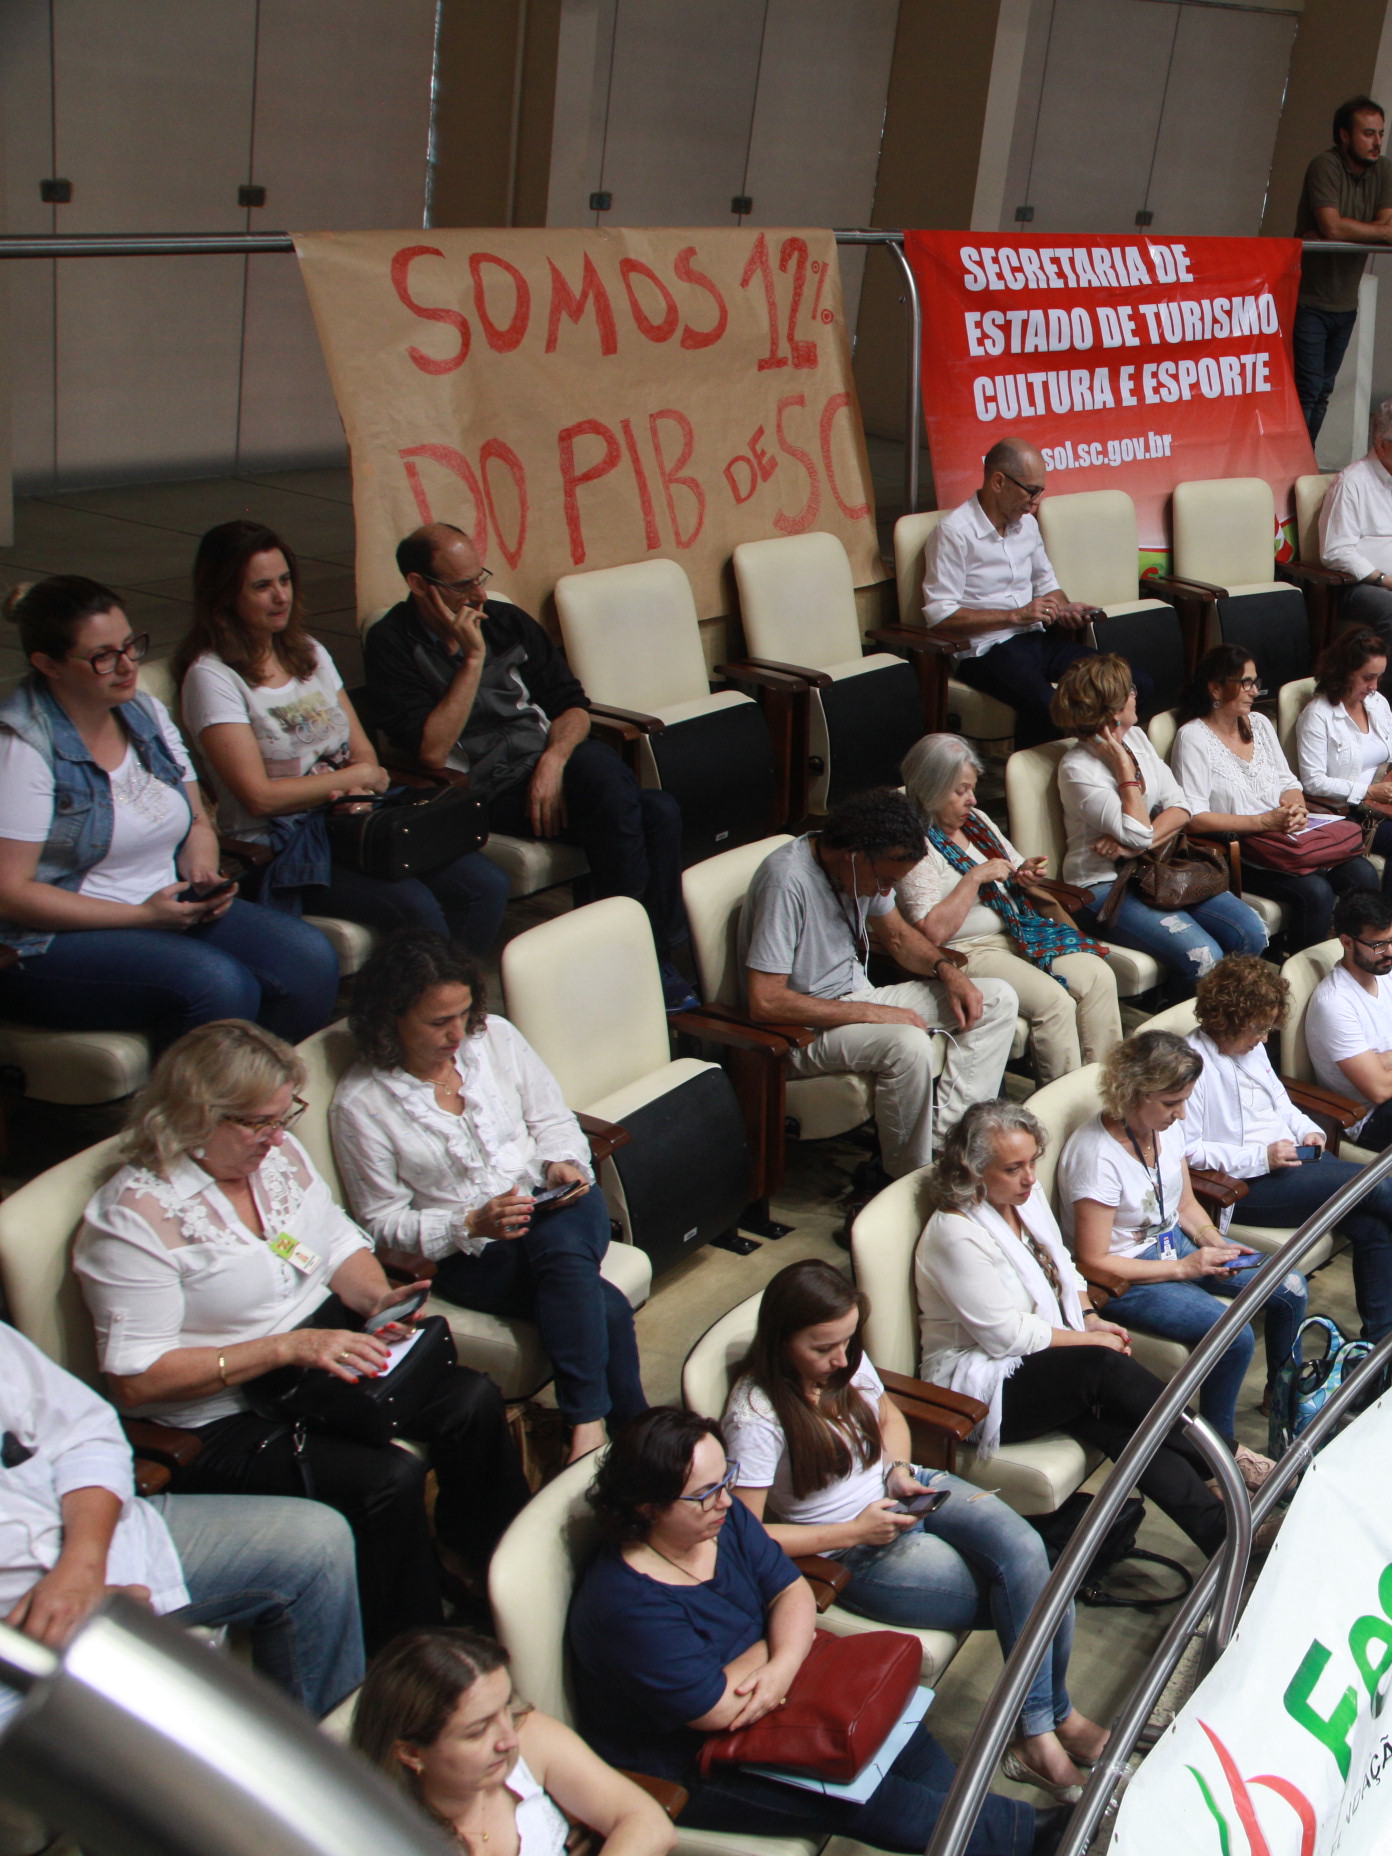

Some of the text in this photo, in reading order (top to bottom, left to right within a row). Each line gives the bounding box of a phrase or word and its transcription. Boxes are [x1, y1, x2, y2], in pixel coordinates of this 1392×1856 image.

[959, 244, 1194, 292] SECRETARIA DE
[390, 231, 833, 376] SOMOS 12%
[964, 307, 1094, 357] ESTADO
[1096, 305, 1140, 349] DE
[973, 352, 1271, 422] CULTURA E ESPORTE
[399, 392, 871, 571] DO PIB DE SC
[981, 431, 1172, 472] sol.sc.gov.br
